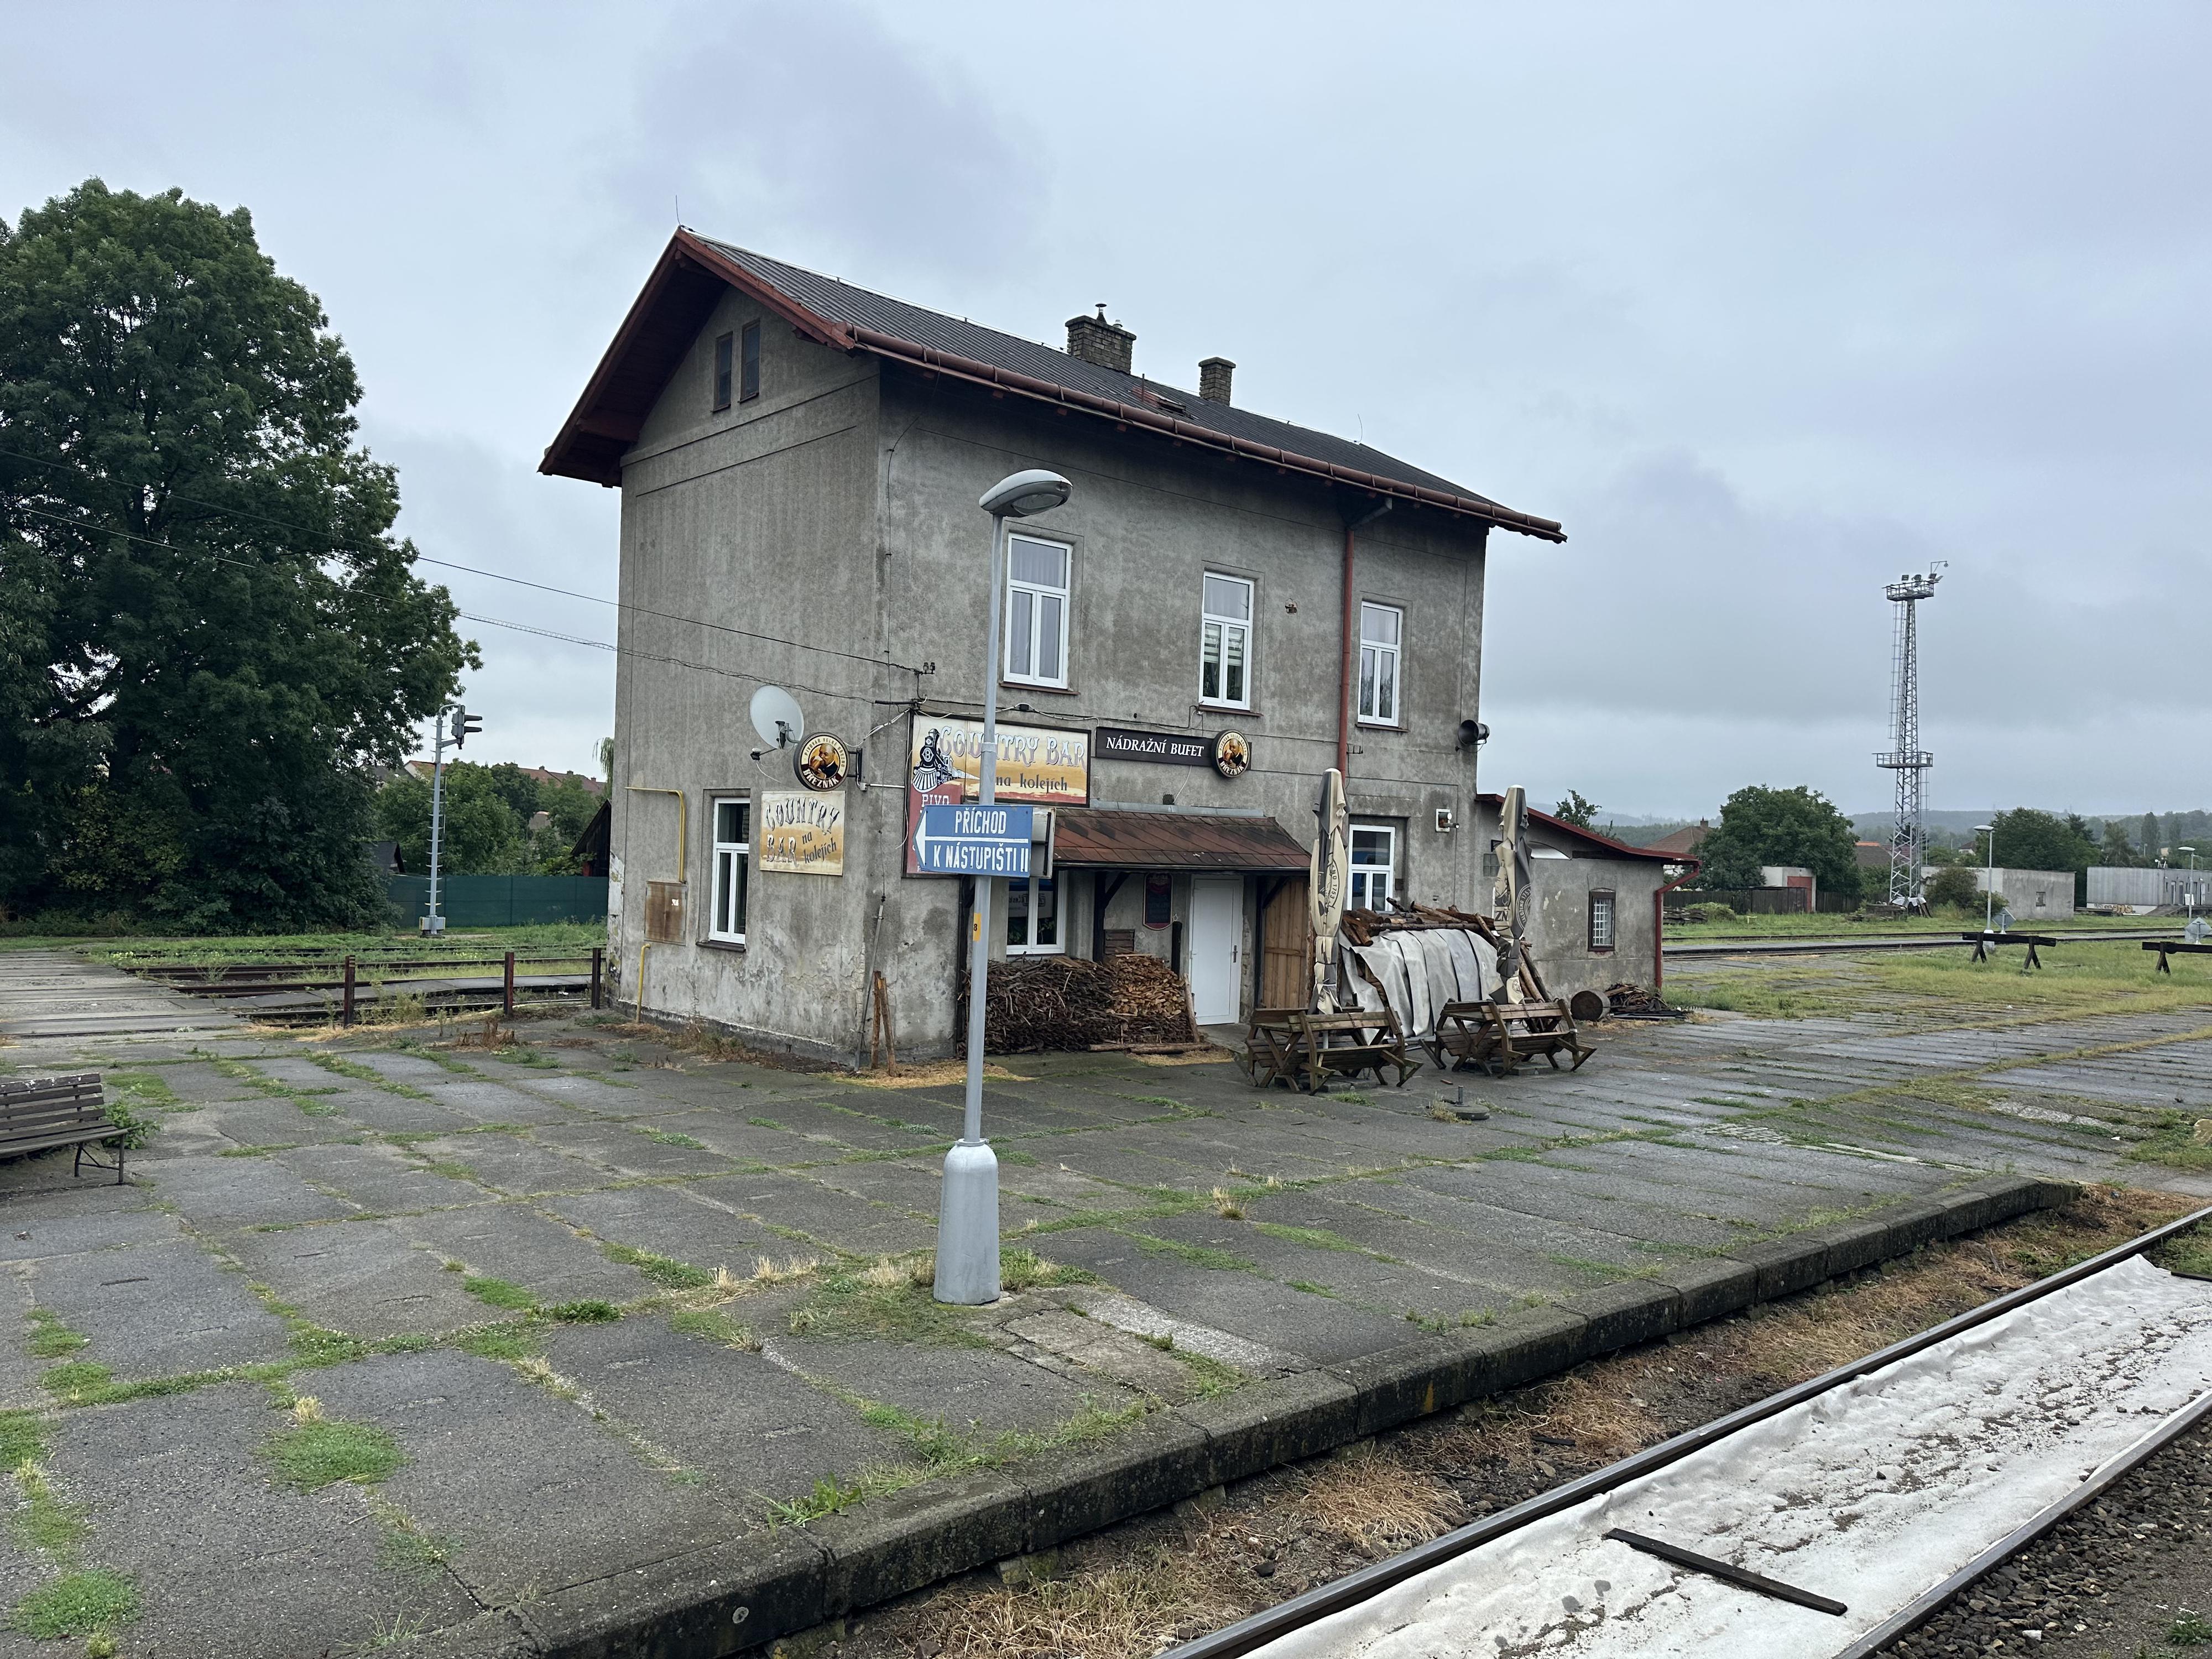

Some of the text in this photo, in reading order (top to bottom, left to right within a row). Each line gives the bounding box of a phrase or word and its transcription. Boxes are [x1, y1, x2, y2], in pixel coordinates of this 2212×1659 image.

[1046, 735, 1087, 773] BAR
[1106, 735, 1204, 757] NÁDRAŽNÍ BUFET
[996, 773, 1067, 794] na kolejích
[765, 797, 840, 836] COUNTRY
[954, 807, 1006, 834] PŘÍCHOD
[766, 833, 800, 867] BAR
[802, 832, 812, 844] na
[804, 837, 837, 864] kolejích
[933, 842, 1029, 872] K NÁSTUPIŠTI II
